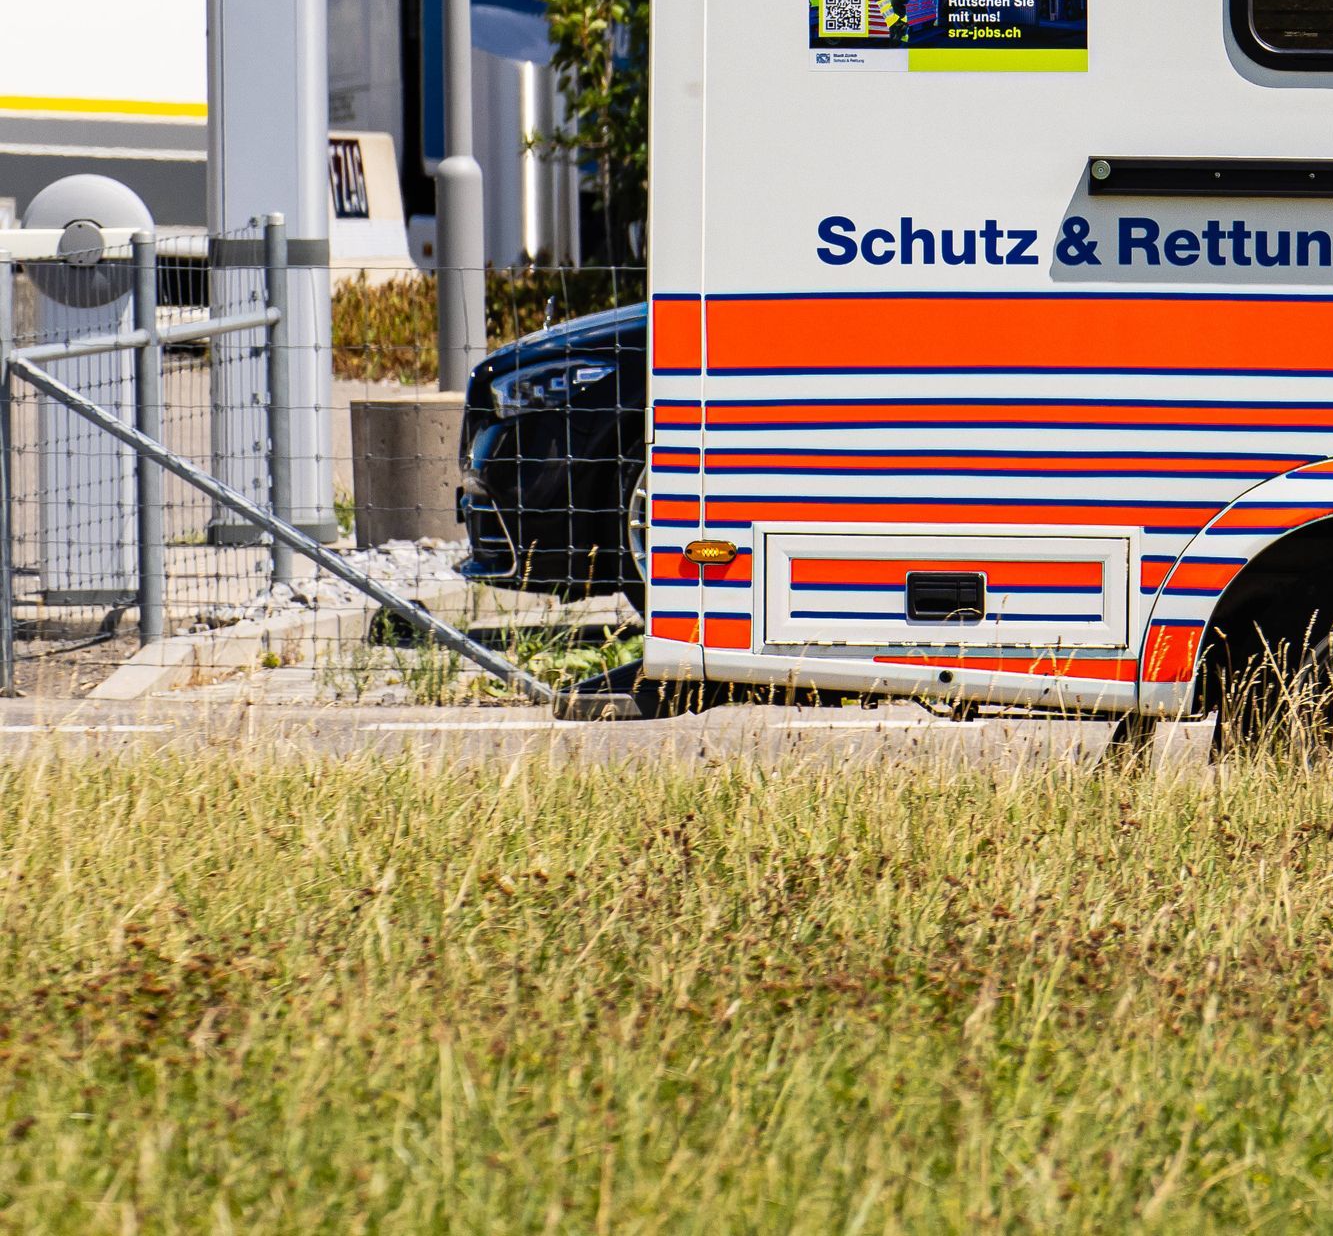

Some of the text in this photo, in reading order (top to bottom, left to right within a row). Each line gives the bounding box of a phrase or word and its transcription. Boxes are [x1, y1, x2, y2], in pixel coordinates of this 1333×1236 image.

[948, 10, 1001, 23] mit uns!
[948, 26, 1021, 40] srz-jobs.ch
[816, 215, 1039, 266] Schutz
[1055, 215, 1101, 267] &
